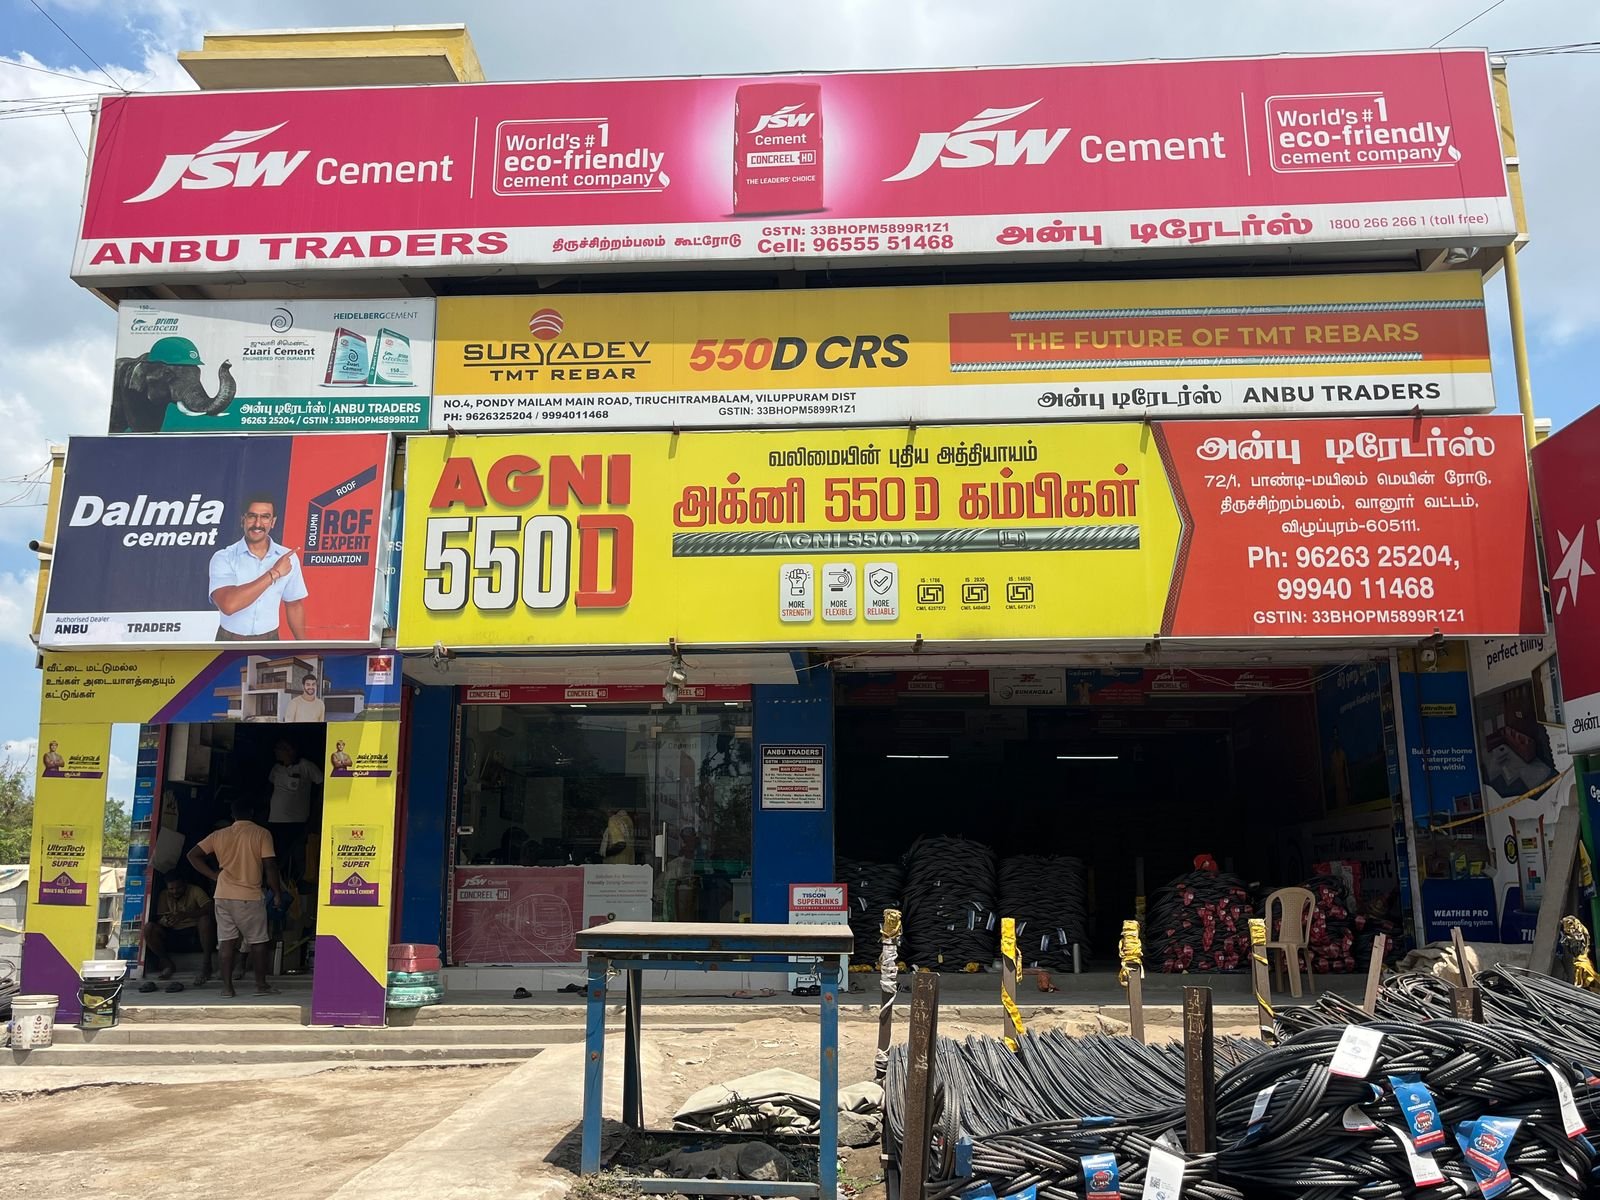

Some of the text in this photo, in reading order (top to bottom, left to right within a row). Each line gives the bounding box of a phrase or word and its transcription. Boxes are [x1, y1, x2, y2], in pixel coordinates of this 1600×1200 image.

[747, 104, 815, 133] JSW
[1277, 109, 1358, 127] World's
[506, 133, 580, 151] World's
[755, 133, 807, 146] Cement
[882, 102, 1226, 181] JSW Cement
[1279, 122, 1450, 148] eco-friendly
[123, 124, 453, 203] JSW Cement
[504, 149, 664, 172] eco-friendly
[750, 152, 813, 165] CONCREEL HD
[1281, 147, 1442, 165] cement company
[503, 172, 654, 188] cement company
[762, 223, 949, 236] GSTN: 33BHOPM5899R1Z1
[996, 212, 1313, 245] அன்பு டிரேடர்ஸ்
[1329, 219, 1360, 230] 1800
[1364, 217, 1388, 229] 266
[1392, 216, 1417, 227] 266
[1430, 214, 1455, 226] (toll
[1458, 213, 1489, 225] free)
[90, 231, 508, 265] ANBU TRADERS
[553, 233, 741, 252] திருச்சிற்றம்பலம் கூட்ரோடு
[757, 234, 953, 253] Cell: 96555 51468
[333, 312, 418, 320] HEIDELBERGCEMENT
[1151, 308, 1200, 316] SURYADEV
[130, 322, 179, 332] Greencem
[1011, 322, 1420, 351] THE FUTURE OF TMT REBARS
[243, 347, 316, 356] Zuari Cement
[464, 341, 650, 365] SURYADEV
[689, 333, 910, 372] 550D CRS
[490, 367, 636, 381] TMT REBAR
[1037, 384, 1222, 409] அன்பு டிரேடர்ஸ்
[1243, 382, 1441, 403] ANBU TRADERS
[240, 401, 326, 415] அன்பு டிரேடர்ஸ்
[332, 403, 422, 414] ANBU TRADERS
[443, 392, 857, 410] NO.4, PONDY MAILAM MAIN ROAD, TIRUCHITRAMBALAM, VILUPPURAM DIST
[443, 413, 462, 421] PH:
[465, 411, 532, 421] 9626325204
[541, 410, 609, 420] 9994011468
[718, 404, 857, 416] GSTIN: 33BHOPM5899R1Z1
[241, 416, 267, 425] 96263
[268, 416, 295, 425] 25204
[303, 416, 329, 424] GSTIN
[335, 416, 419, 424] 33BHOPM5899R1Z1
[769, 439, 1038, 468] வலிமையின் புதிய அத்தியாயம்
[1197, 427, 1495, 464] அன்பு டிரேடர்ஸ்
[429, 454, 632, 508] AGNI
[1251, 471, 1368, 490] பாண்டி-மயிலம்
[1377, 470, 1435, 486] மெயின்
[1444, 469, 1491, 487] ரோடு,
[335, 480, 357, 496] ROOF
[673, 472, 806, 528] அக்னி
[959, 463, 1141, 521] கம்பிகள்
[69, 494, 225, 527] Dalmia
[1220, 493, 1479, 515] திருச்சிற்றம்பலம், வானூர் வட்டம்,
[308, 513, 319, 546] COLUMN
[323, 509, 374, 534] RCF
[123, 527, 218, 548] cement
[321, 536, 371, 551] EXPERT
[774, 531, 894, 549] AGNI 550
[310, 555, 361, 564] FOUNDATION
[423, 513, 635, 611] 550D
[1248, 545, 1460, 571] Ph: 96263 25204,
[1278, 577, 1434, 600] 99940 11468
[788, 600, 805, 608] MORE
[830, 600, 848, 608] MORE
[872, 599, 889, 607] MORE
[782, 608, 812, 617] STRENGTH
[825, 608, 853, 616] FLEXIBLE
[867, 608, 895, 616] RELIABLE
[1253, 609, 1465, 624] GSTIN: 33BHOPM5899R1Z1
[54, 622, 181, 634] ANBU TRADERS
[1486, 644, 1519, 669] perfect
[46, 663, 138, 674] வீட்டை மட்டுமல்ல
[46, 676, 176, 687] உங்கள் அடையாளத்தையும்
[45, 690, 95, 701] கட்டுங்கள்
[469, 689, 497, 698] CONCREEL
[567, 688, 595, 697] CONCREEL
[47, 844, 85, 852] UltraTech
[337, 844, 376, 852] UltraTech
[462, 875, 508, 887] JSW Cement
[459, 890, 494, 900] CONCREEL
[1434, 909, 1489, 917] WEATHER PRO
[1432, 919, 1493, 927] waterproofing system
